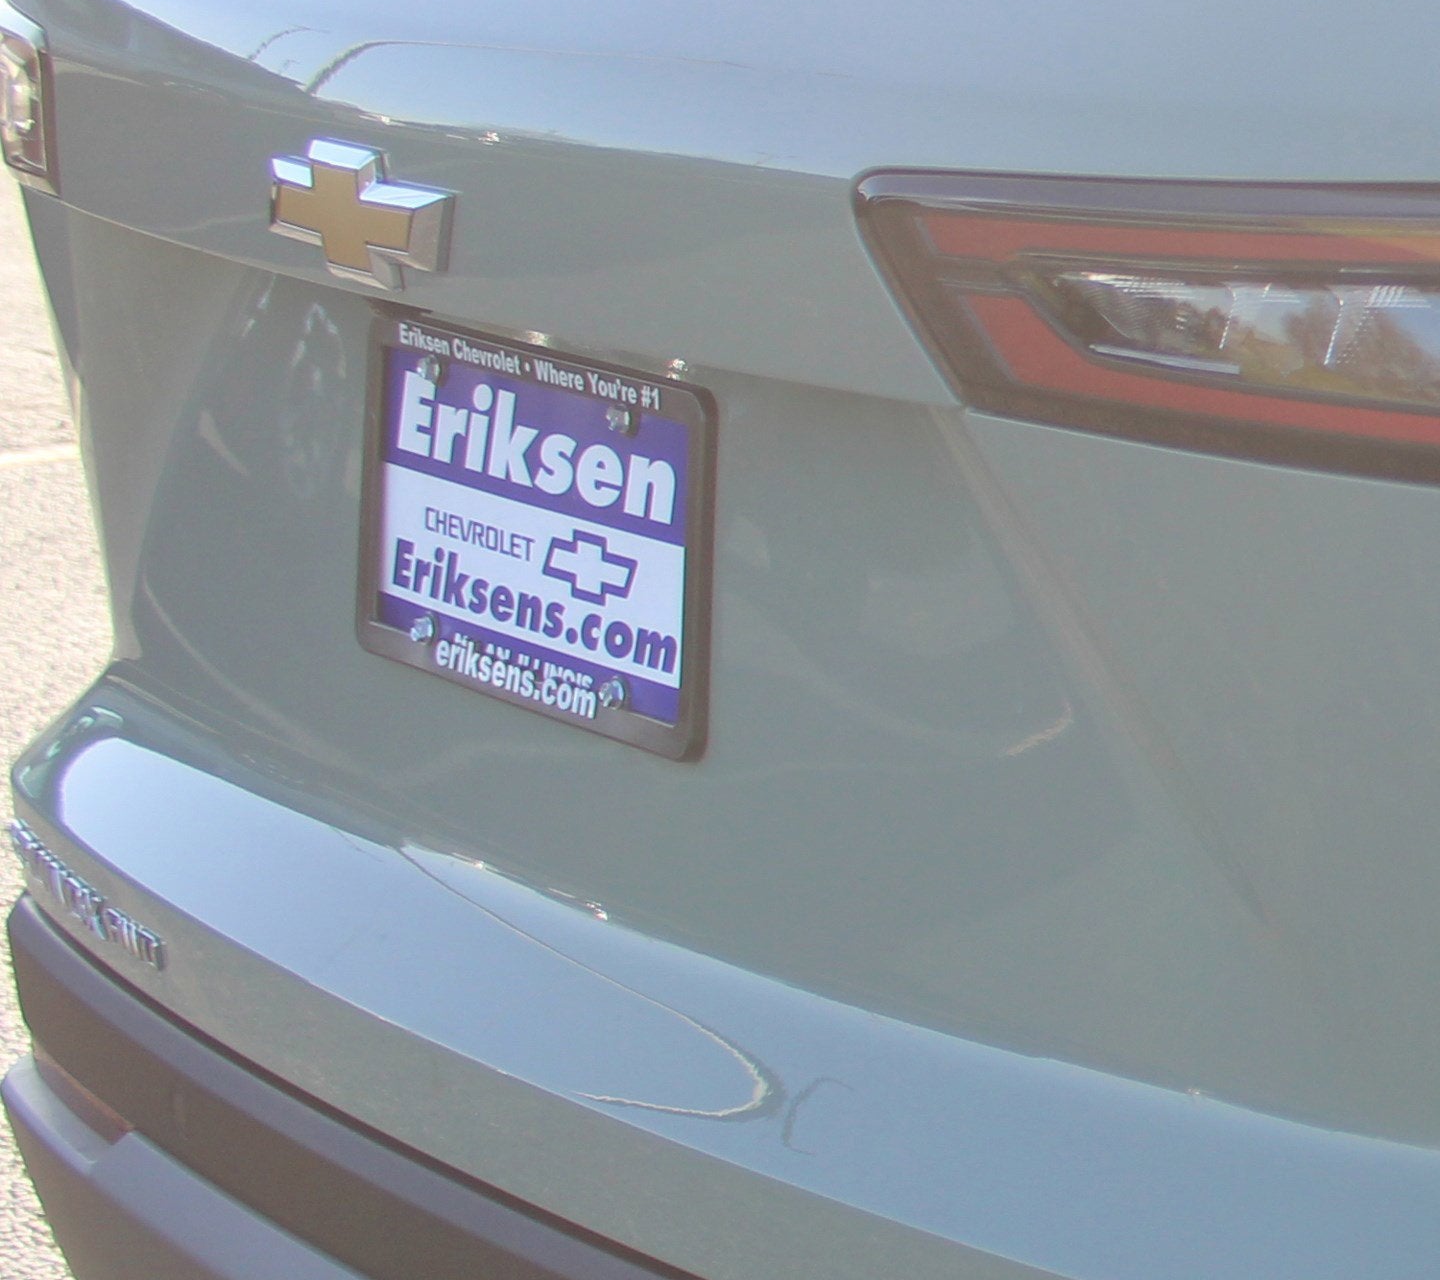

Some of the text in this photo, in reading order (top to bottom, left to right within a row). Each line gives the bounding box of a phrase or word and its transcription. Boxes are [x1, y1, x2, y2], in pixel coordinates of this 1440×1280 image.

[398, 322, 660, 410] Eriksen Chevrolet Where You're #1
[397, 370, 678, 525] Eriksen
[425, 506, 535, 562] CHEVROLET
[392, 538, 678, 675] Eriksens.com
[435, 639, 597, 720] eriksens.com
